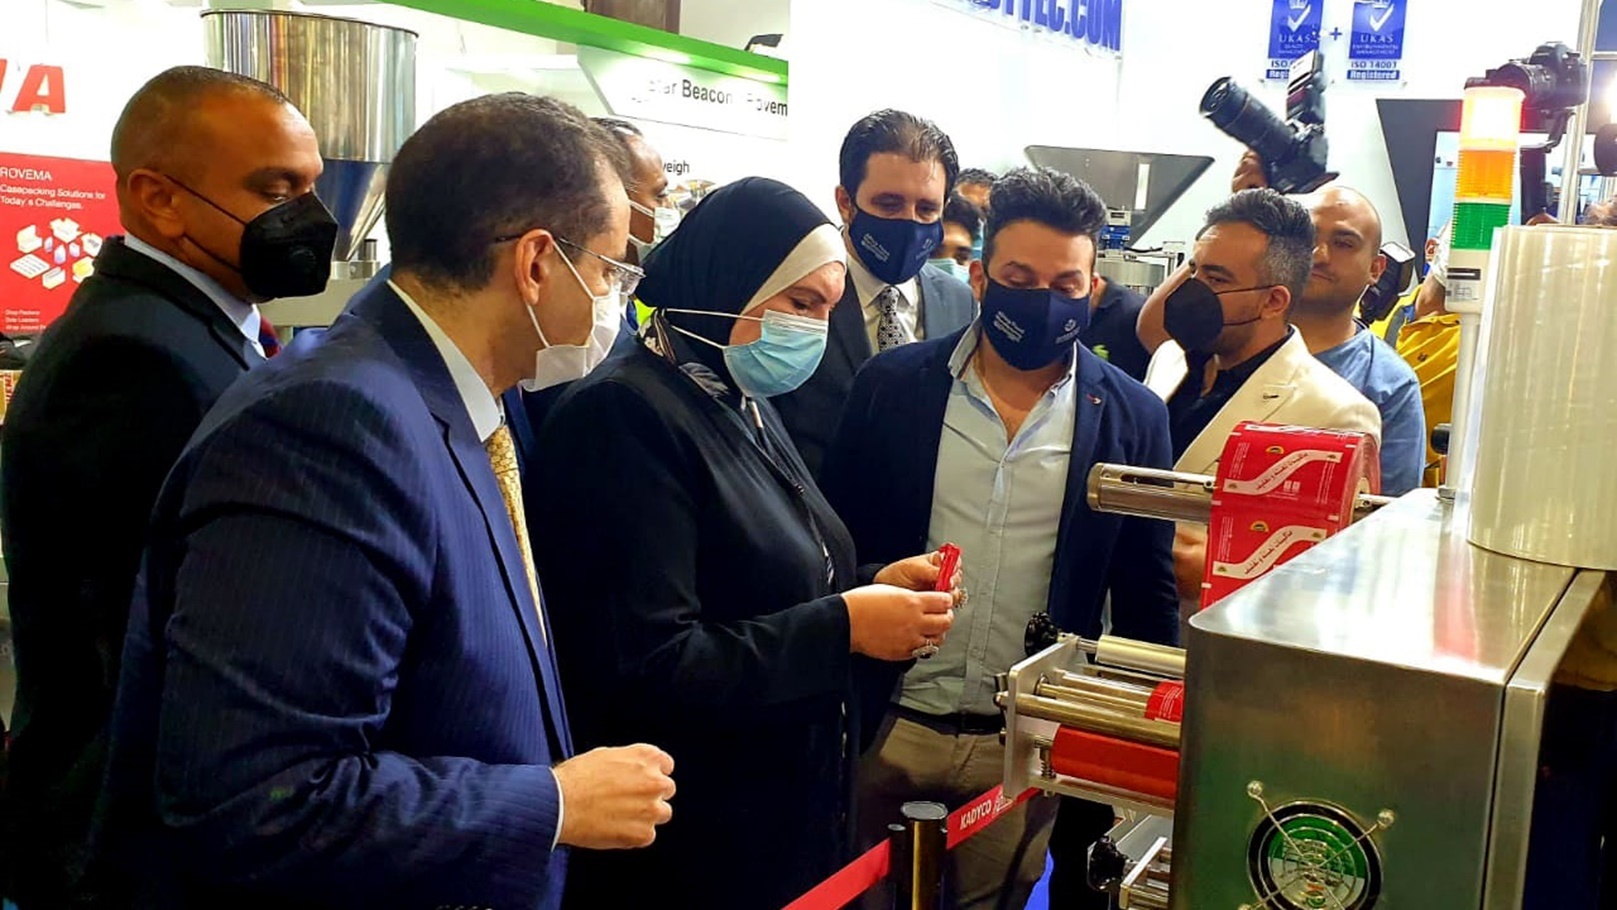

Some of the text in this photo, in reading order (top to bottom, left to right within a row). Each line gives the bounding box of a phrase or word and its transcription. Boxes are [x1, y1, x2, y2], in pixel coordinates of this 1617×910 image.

[1360, 33, 1394, 43] UKAS
[1351, 61, 1367, 69] ISO
[1350, 70, 1397, 79] Registered
[682, 79, 733, 104] Beacon
[0, 166, 52, 181] ROVEMA
[57, 189, 94, 199] Solutions
[960, 799, 992, 830] KADYCO
